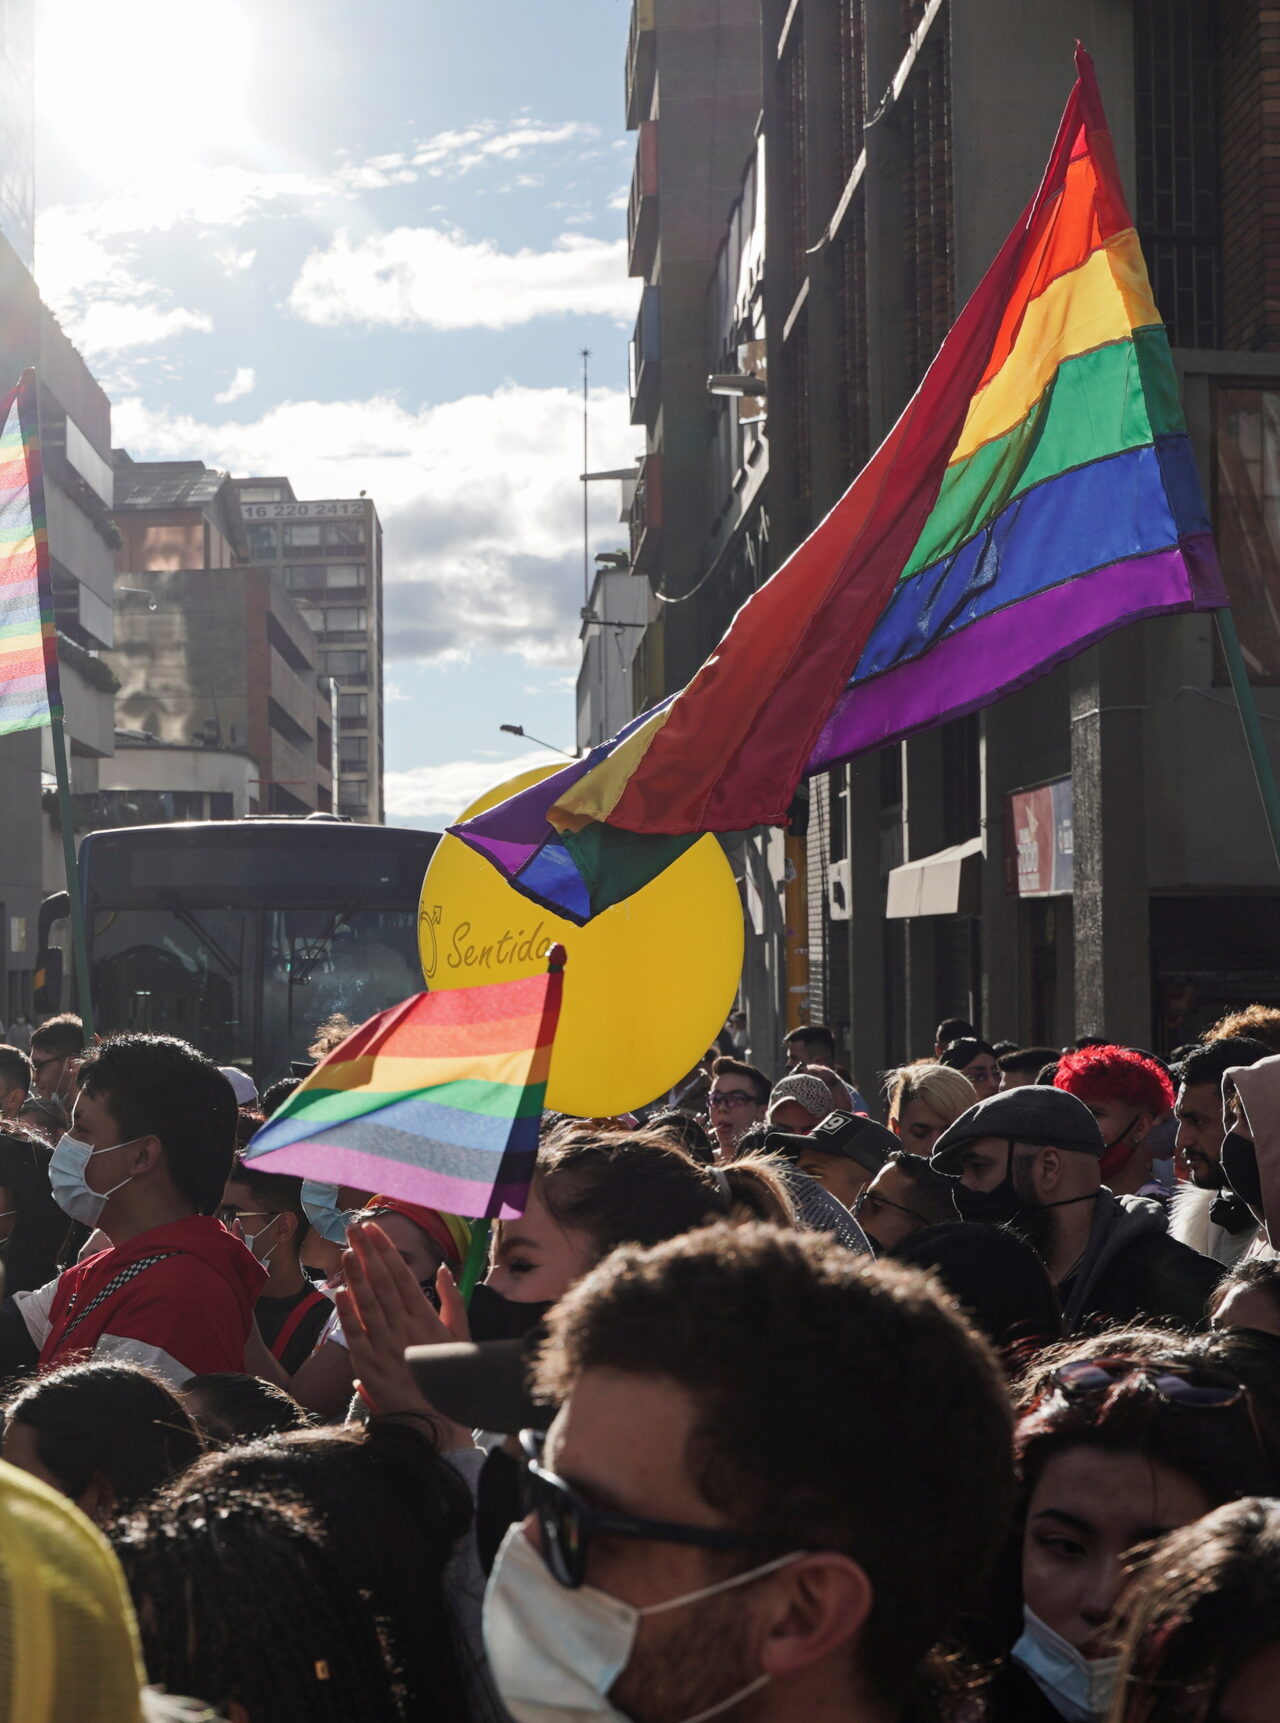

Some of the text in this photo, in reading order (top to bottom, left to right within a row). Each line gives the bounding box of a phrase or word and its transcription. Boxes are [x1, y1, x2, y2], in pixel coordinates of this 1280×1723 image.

[274, 504, 309, 517] 220
[315, 502, 363, 516] 2412
[447, 921, 551, 969] Sentido
[822, 1116, 845, 1130] 9
